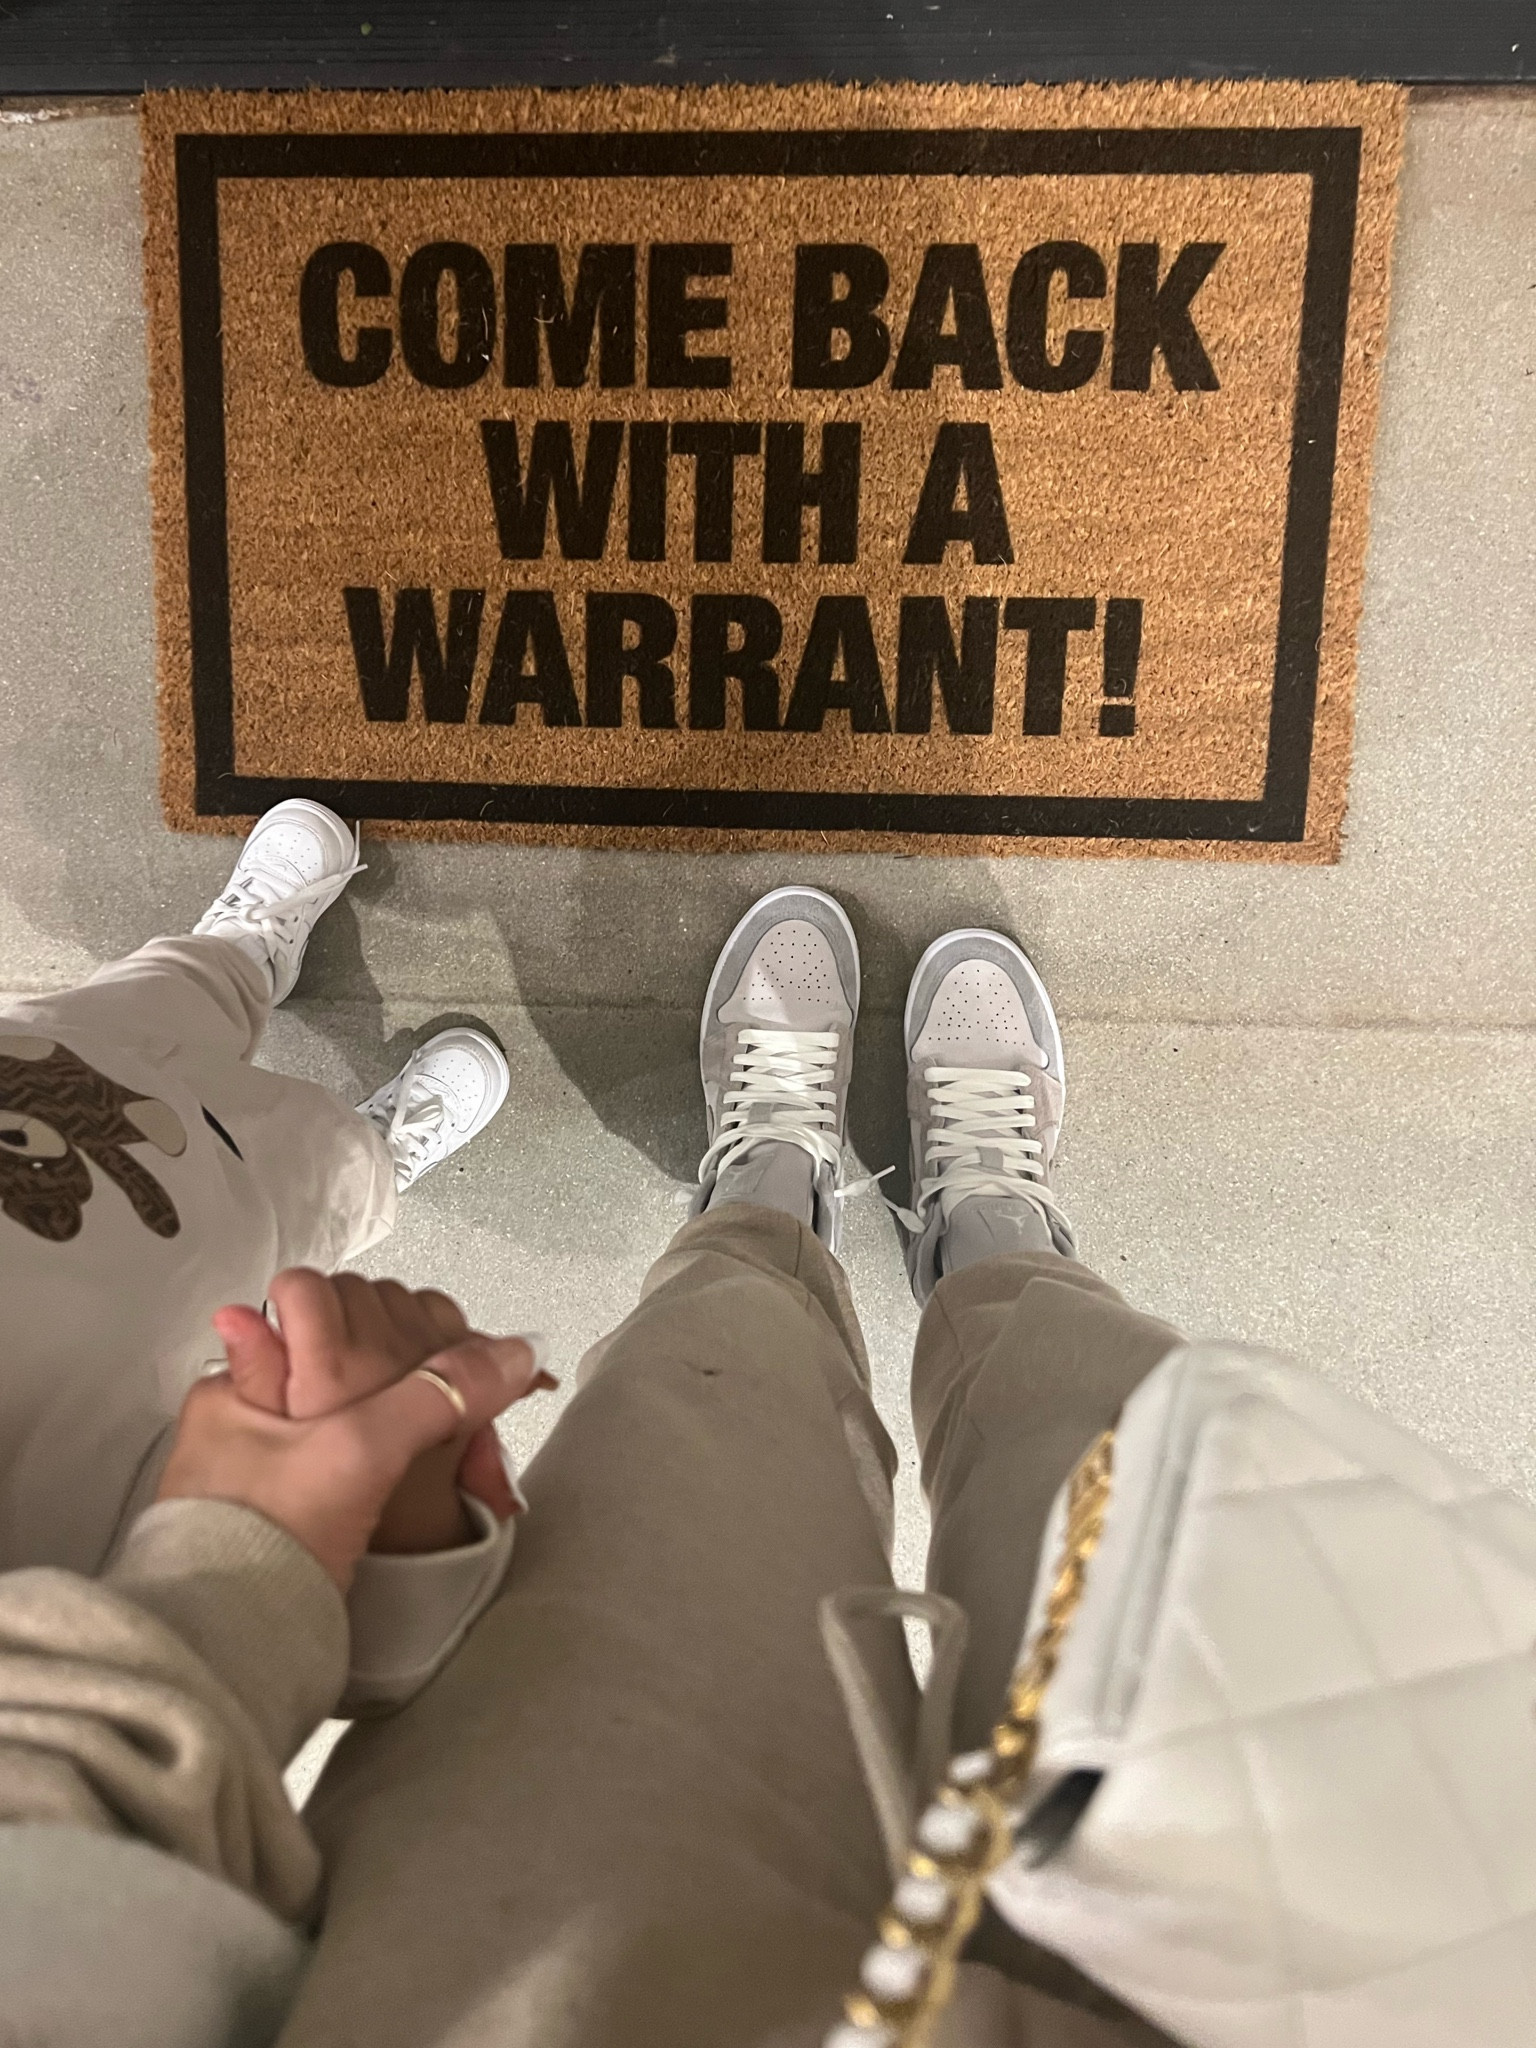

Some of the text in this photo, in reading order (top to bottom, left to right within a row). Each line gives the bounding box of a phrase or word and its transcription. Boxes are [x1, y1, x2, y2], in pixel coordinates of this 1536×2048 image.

[299, 241, 1227, 392] COME BACK
[481, 420, 1014, 565] WITH A
[343, 588, 1143, 737] WARRANT!
